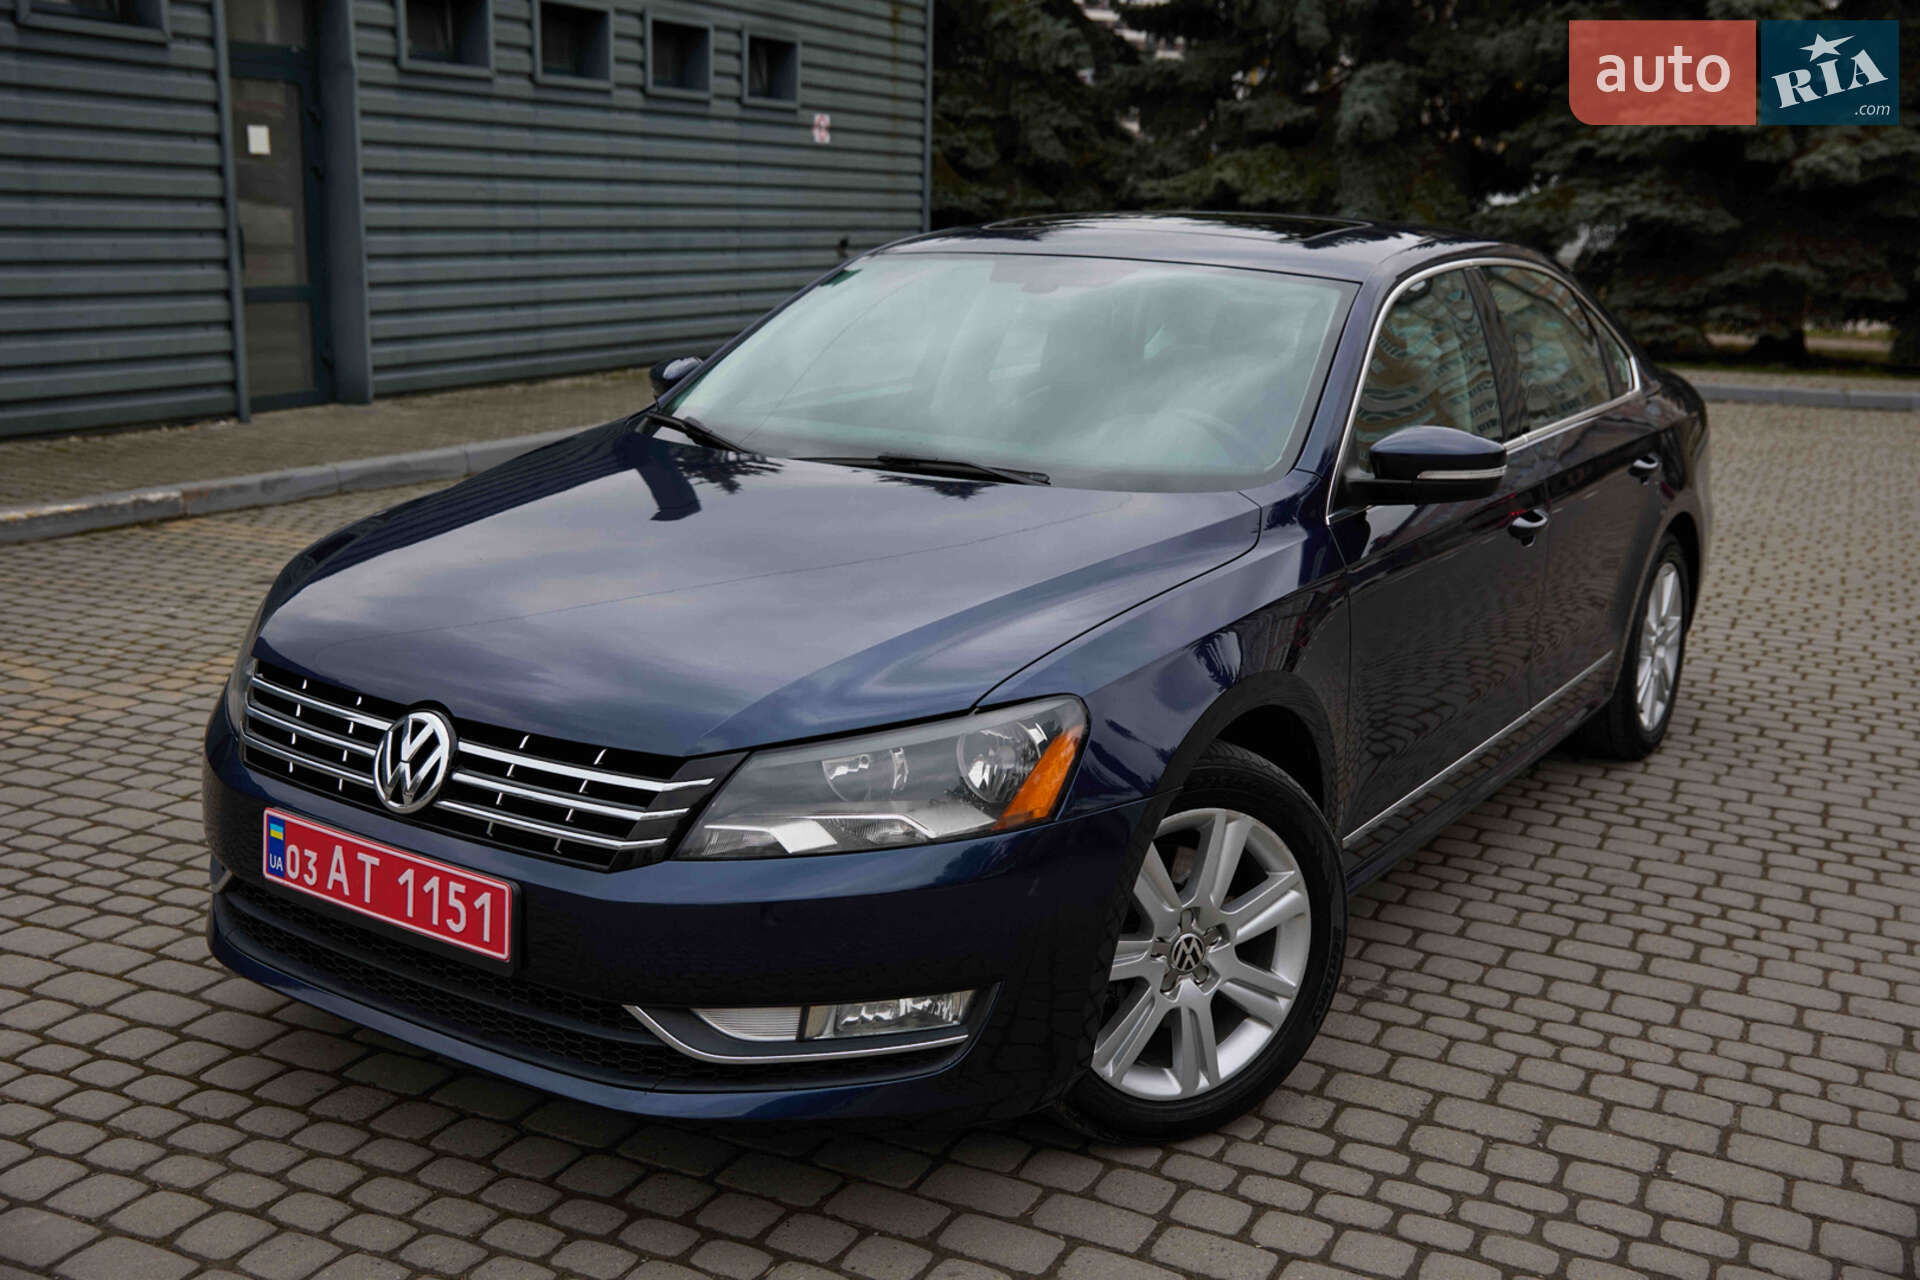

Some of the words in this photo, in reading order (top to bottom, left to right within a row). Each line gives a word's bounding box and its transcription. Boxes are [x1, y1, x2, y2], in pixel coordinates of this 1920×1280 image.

[269, 853, 283, 872] UA
[286, 844, 318, 886] 03
[326, 845, 380, 904] AT
[398, 868, 492, 943] 1151
